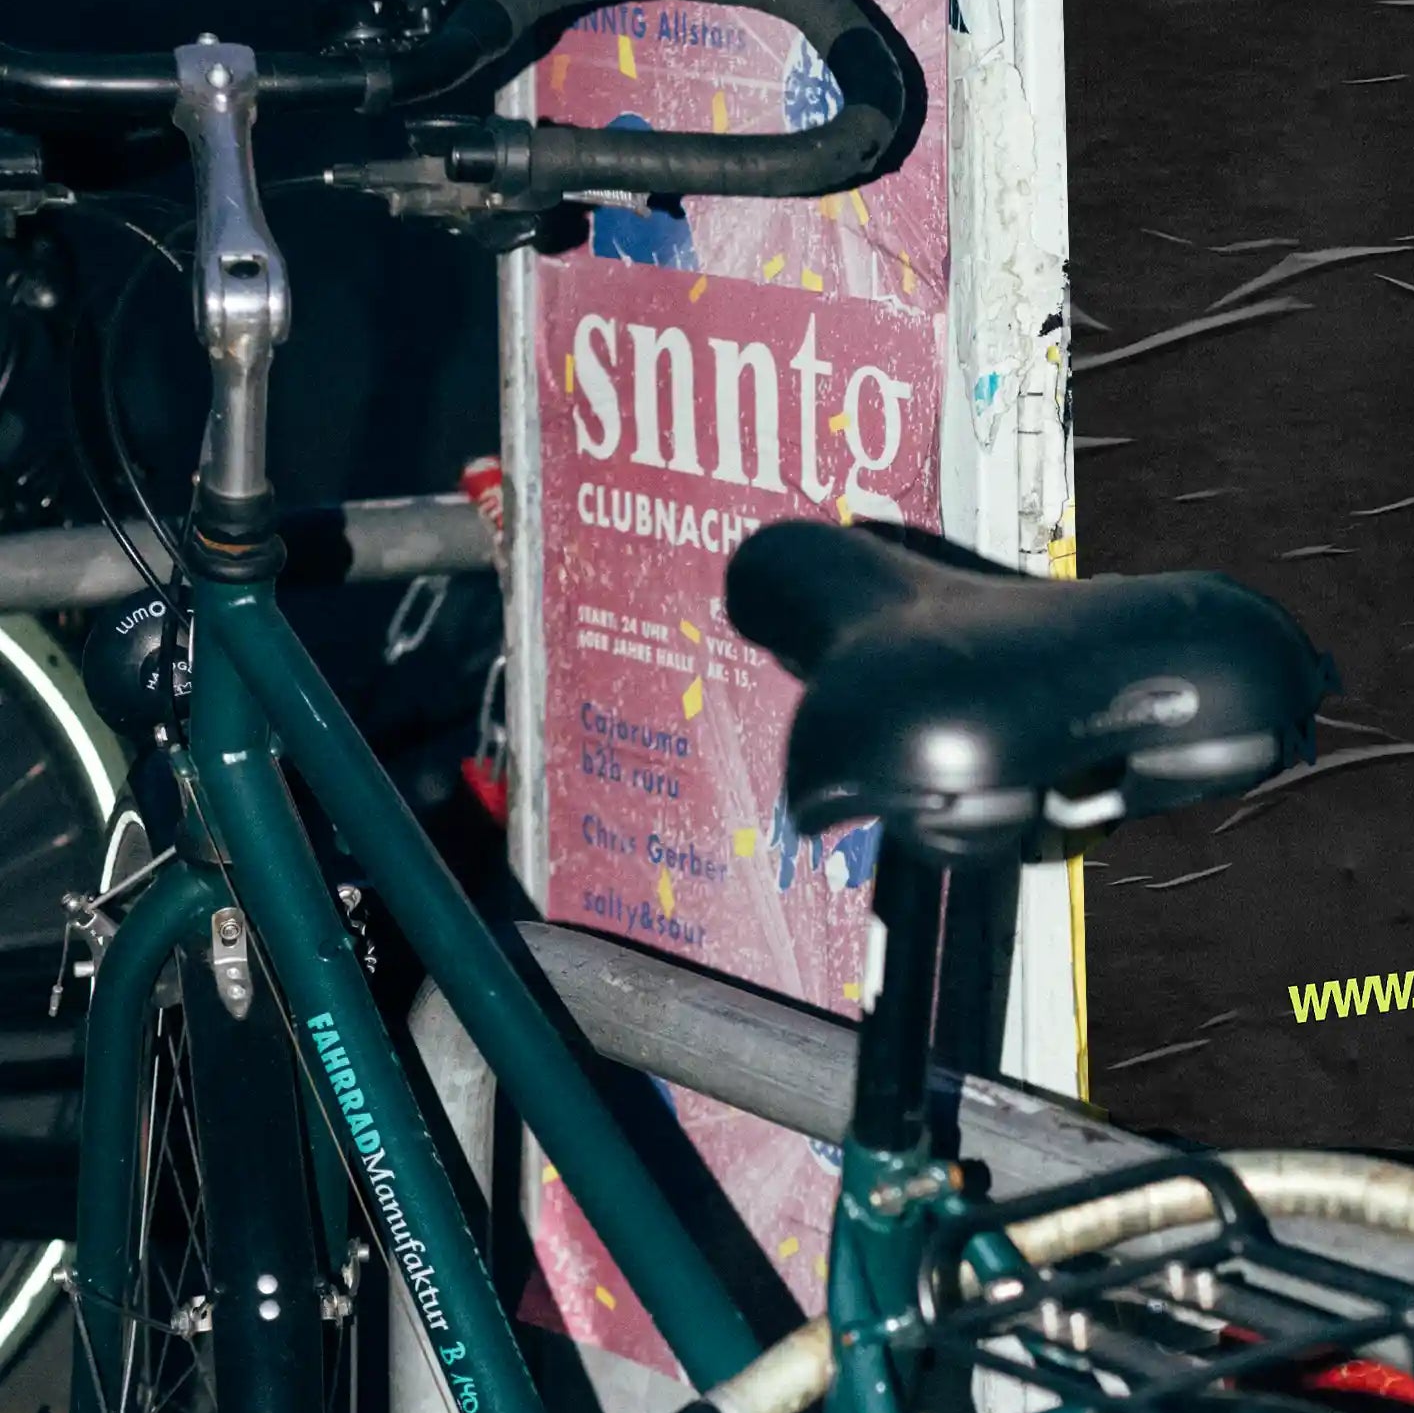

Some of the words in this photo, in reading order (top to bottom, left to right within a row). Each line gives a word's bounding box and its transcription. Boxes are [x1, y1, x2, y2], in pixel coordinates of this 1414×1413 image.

[572, 5, 647, 39] NNTG
[573, 313, 912, 522] snntg
[621, 616, 637, 635] 24
[706, 637, 738, 661] VVK:
[582, 742, 621, 782] b2b
[632, 767, 680, 799] ruru
[582, 813, 637, 854] Chris
[647, 833, 728, 882] Gerber
[439, 1341, 467, 1367] B
